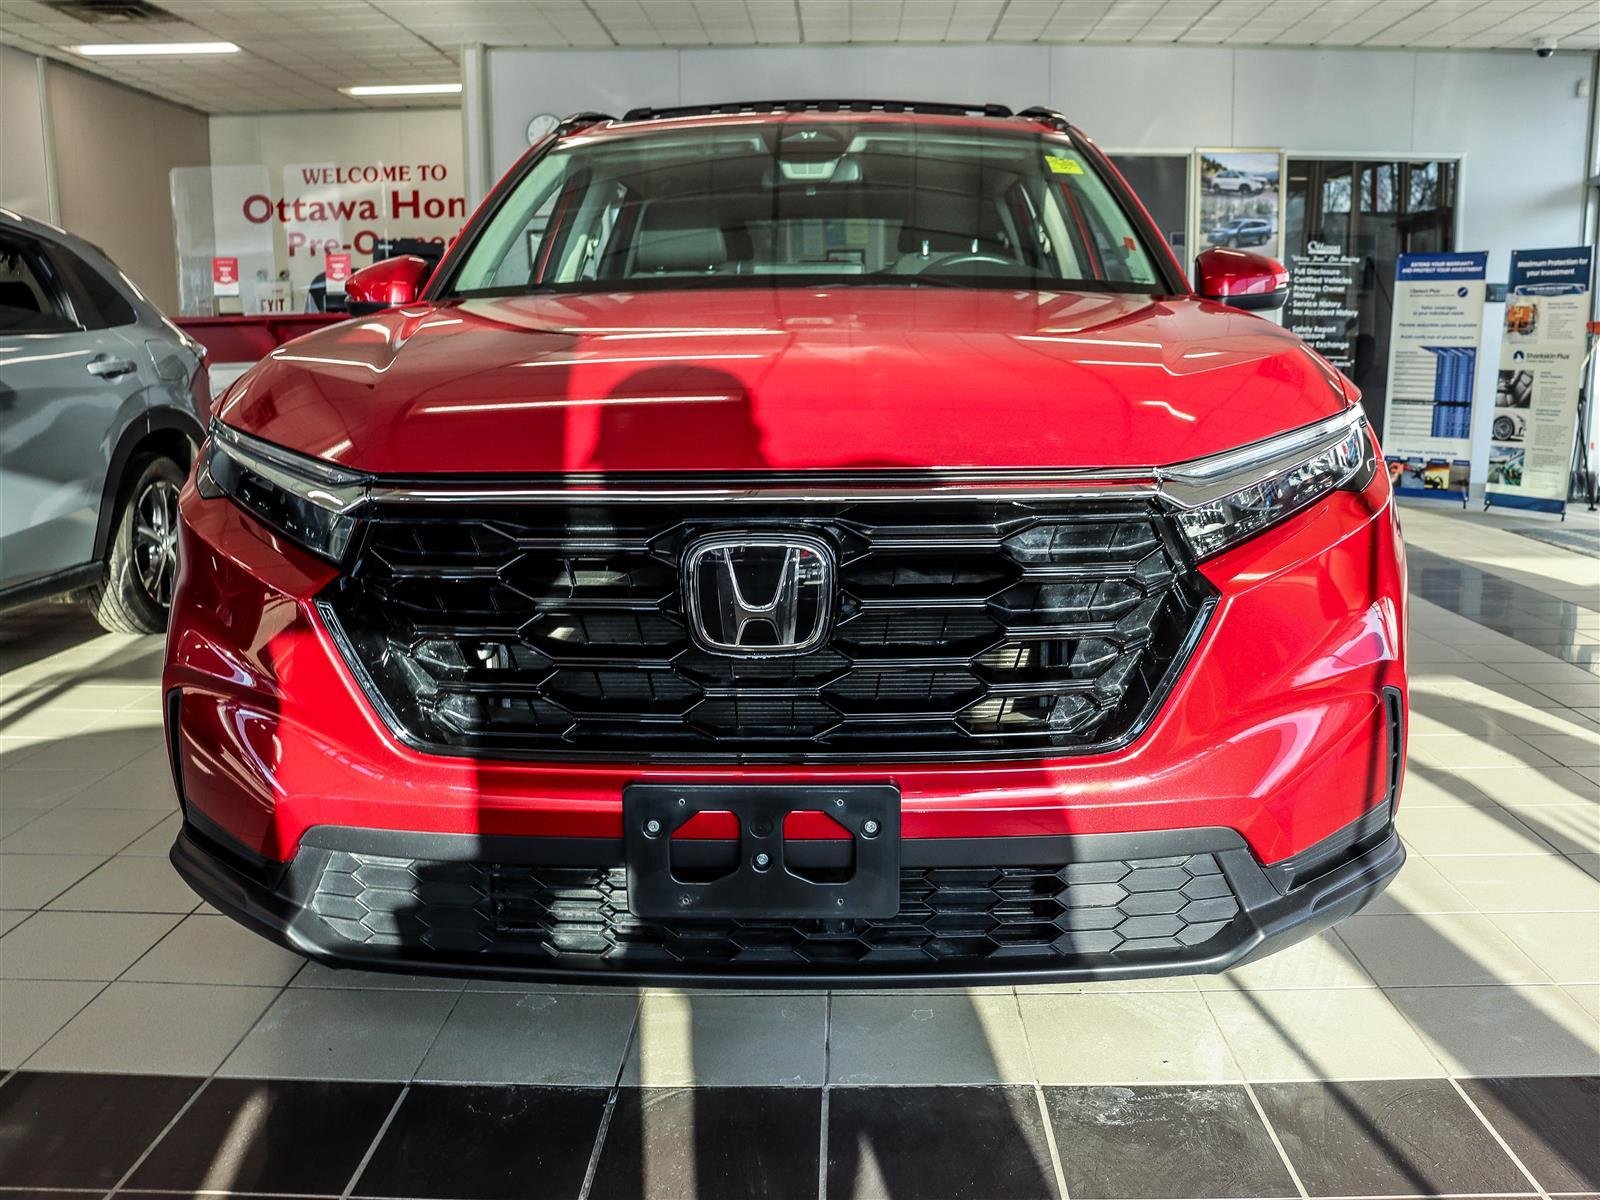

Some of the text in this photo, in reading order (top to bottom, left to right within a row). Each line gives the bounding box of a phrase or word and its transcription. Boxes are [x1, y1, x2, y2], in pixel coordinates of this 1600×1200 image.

[302, 164, 447, 184] WELCOME TO
[243, 194, 378, 224] Ottawa
[288, 229, 462, 257] Pre-Oe
[1517, 257, 1589, 268] Maximum Protection for
[1294, 267, 1341, 276] Full Disclosure
[1526, 270, 1540, 278] your
[1294, 276, 1353, 284] Certified Vehicles
[1293, 285, 1346, 293] Previous Owner
[1293, 292, 1316, 300] History
[1292, 300, 1342, 309] Service History
[1304, 308, 1335, 316] Accident
[1335, 308, 1359, 318] History
[1291, 325, 1313, 334] Safety
[1315, 341, 1350, 350] Exchange
